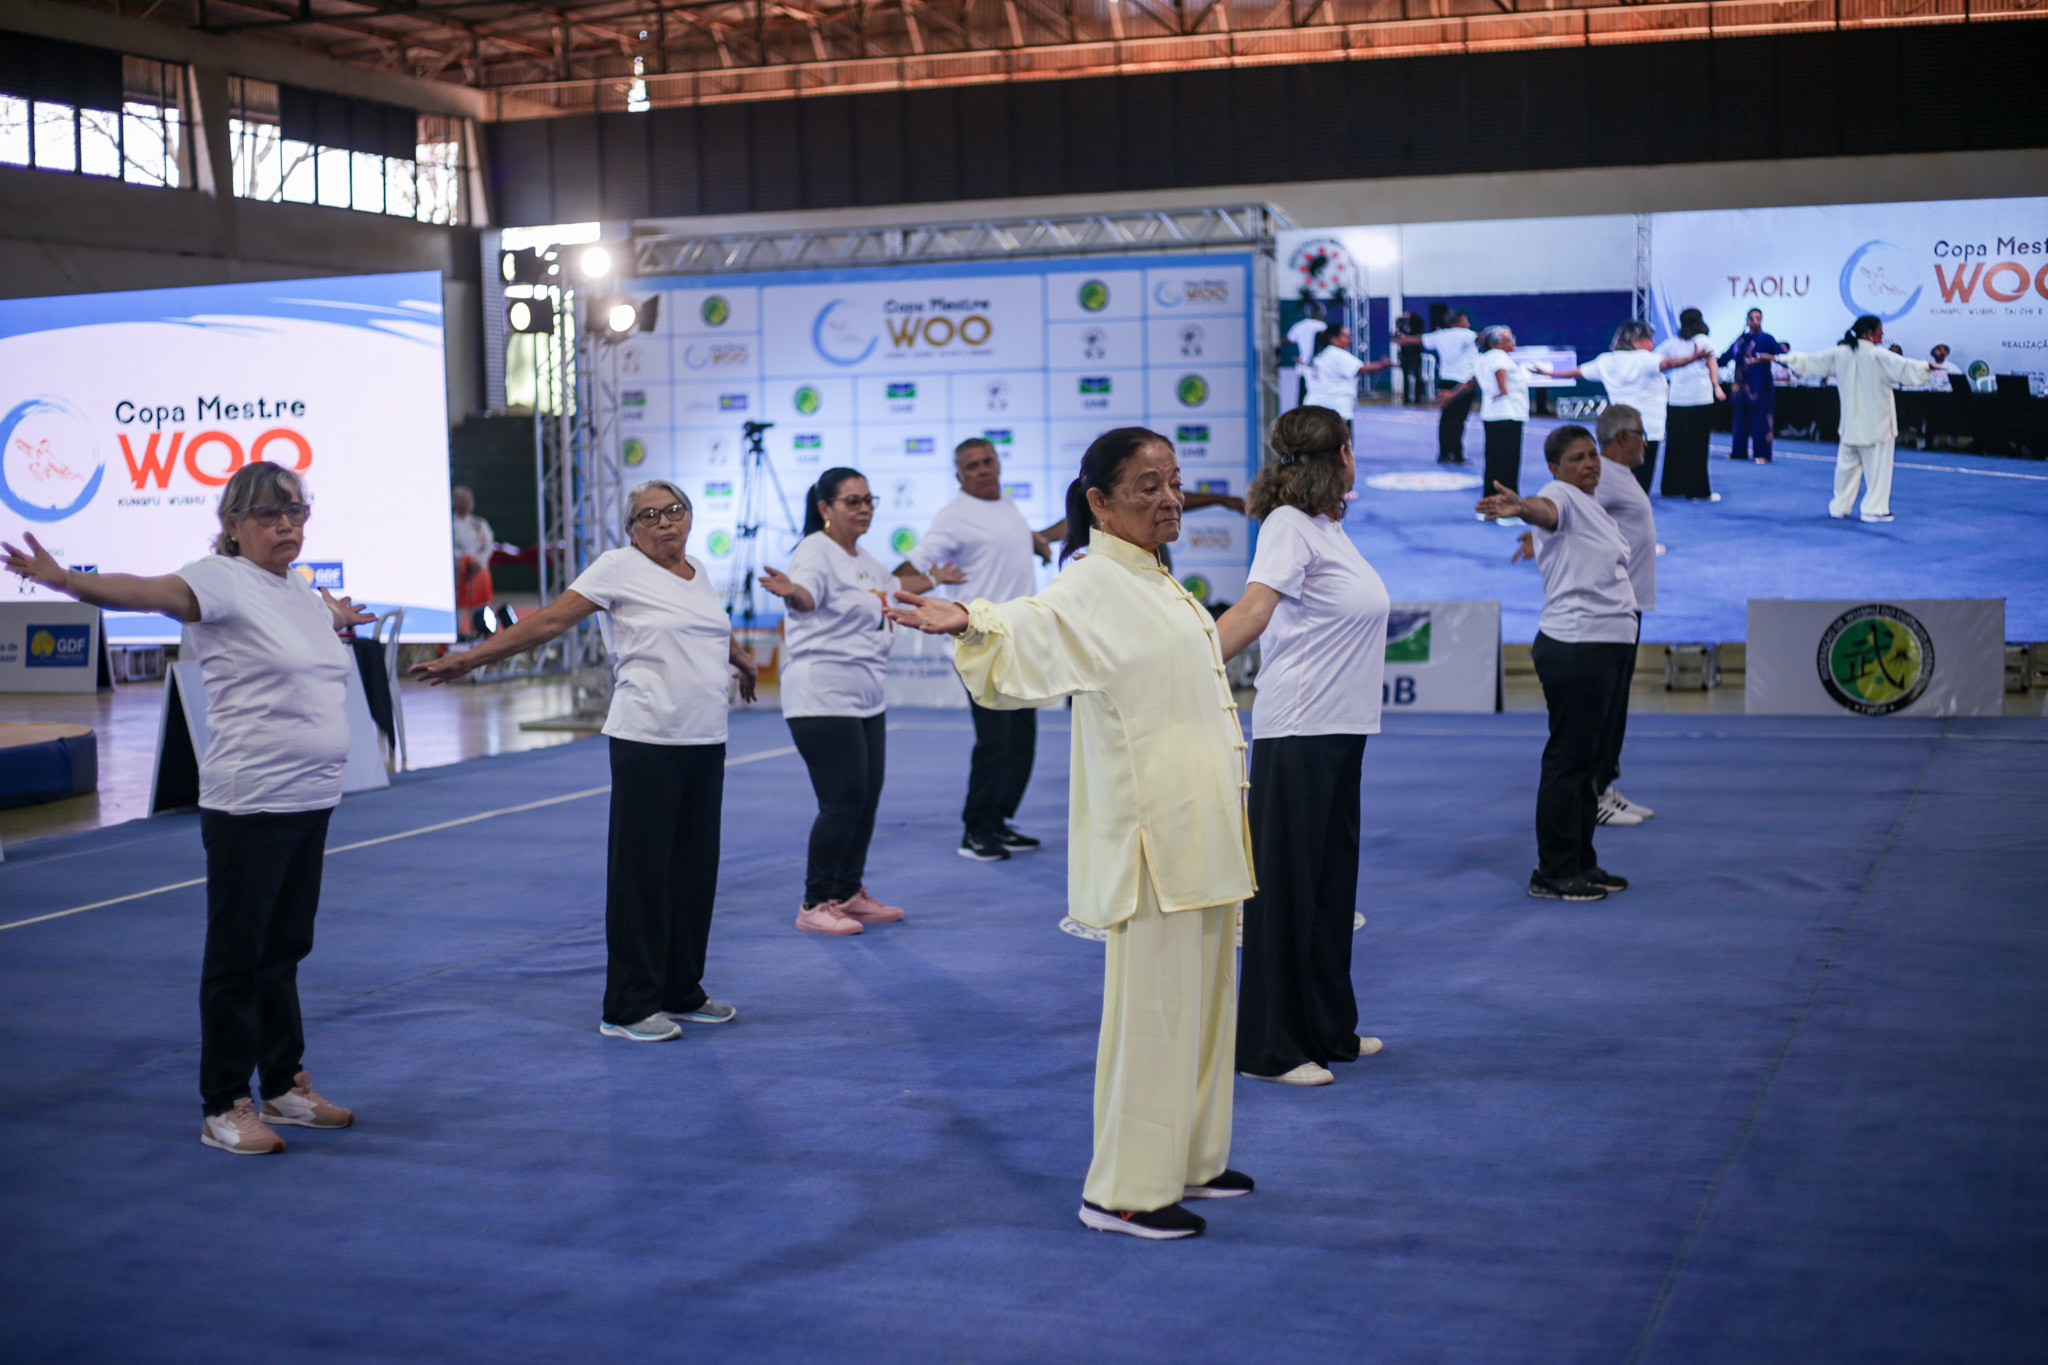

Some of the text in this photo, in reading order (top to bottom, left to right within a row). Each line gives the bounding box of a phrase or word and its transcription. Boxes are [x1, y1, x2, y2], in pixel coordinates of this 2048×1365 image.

[1934, 239, 1987, 262] Copa
[1727, 274, 1811, 298] TAOLU
[1934, 261, 2048, 304] WO
[886, 315, 992, 348] WOO
[115, 394, 306, 430] Copa Mestre
[116, 428, 313, 489] WOO
[56, 637, 87, 653] GDF
